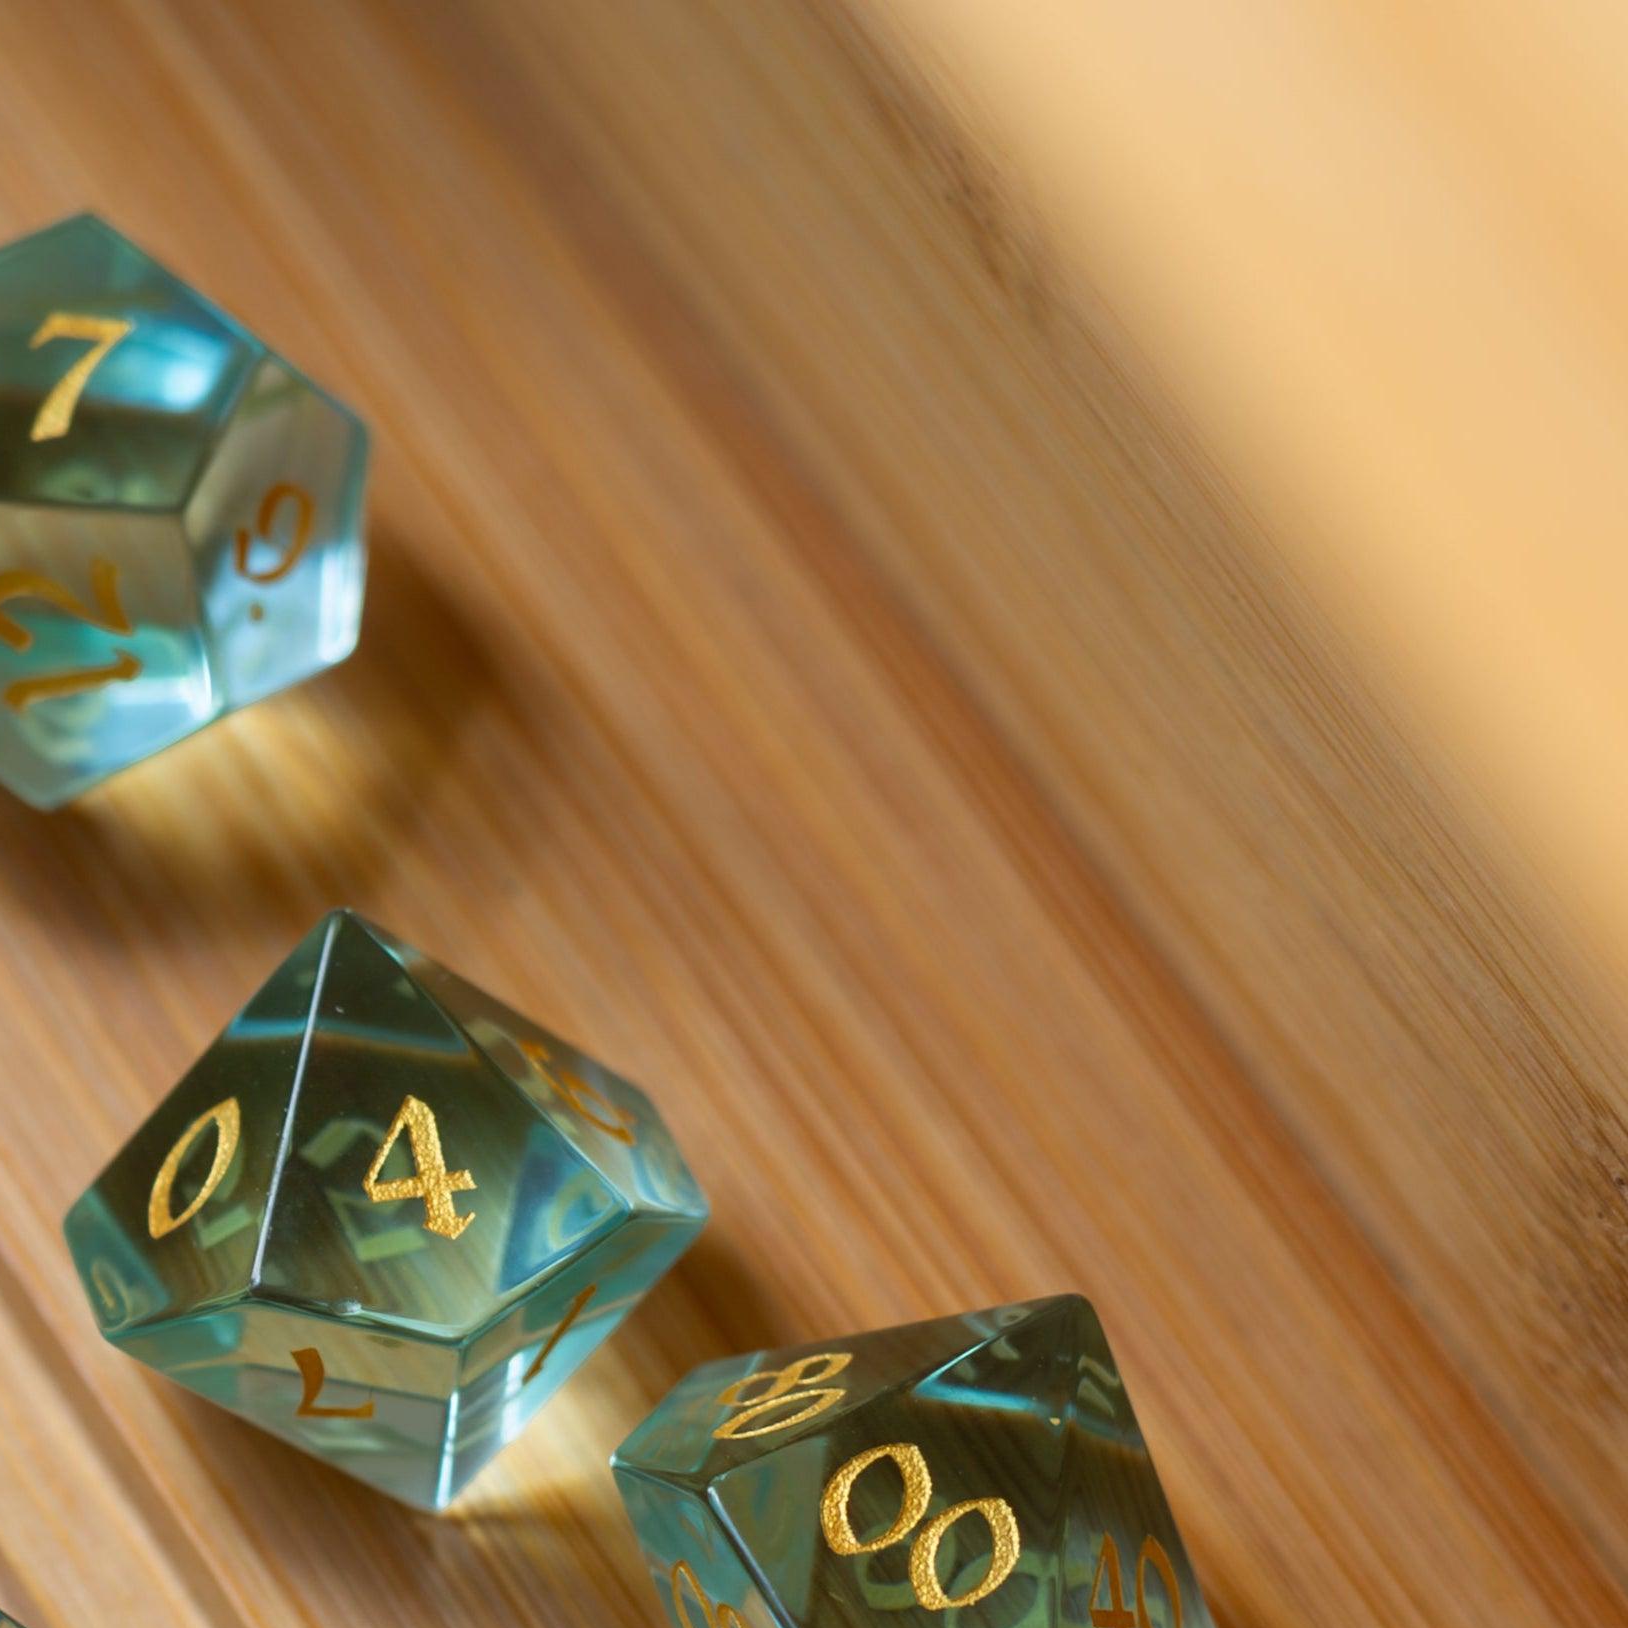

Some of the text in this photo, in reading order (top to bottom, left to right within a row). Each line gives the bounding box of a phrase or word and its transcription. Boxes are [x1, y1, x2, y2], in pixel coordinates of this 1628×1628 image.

[29, 311, 136, 443] 7
[148, 1097, 242, 1241] 0
[364, 1095, 478, 1241] 4
[711, 1352, 854, 1441] 80
[820, 1443, 1023, 1613] 00
